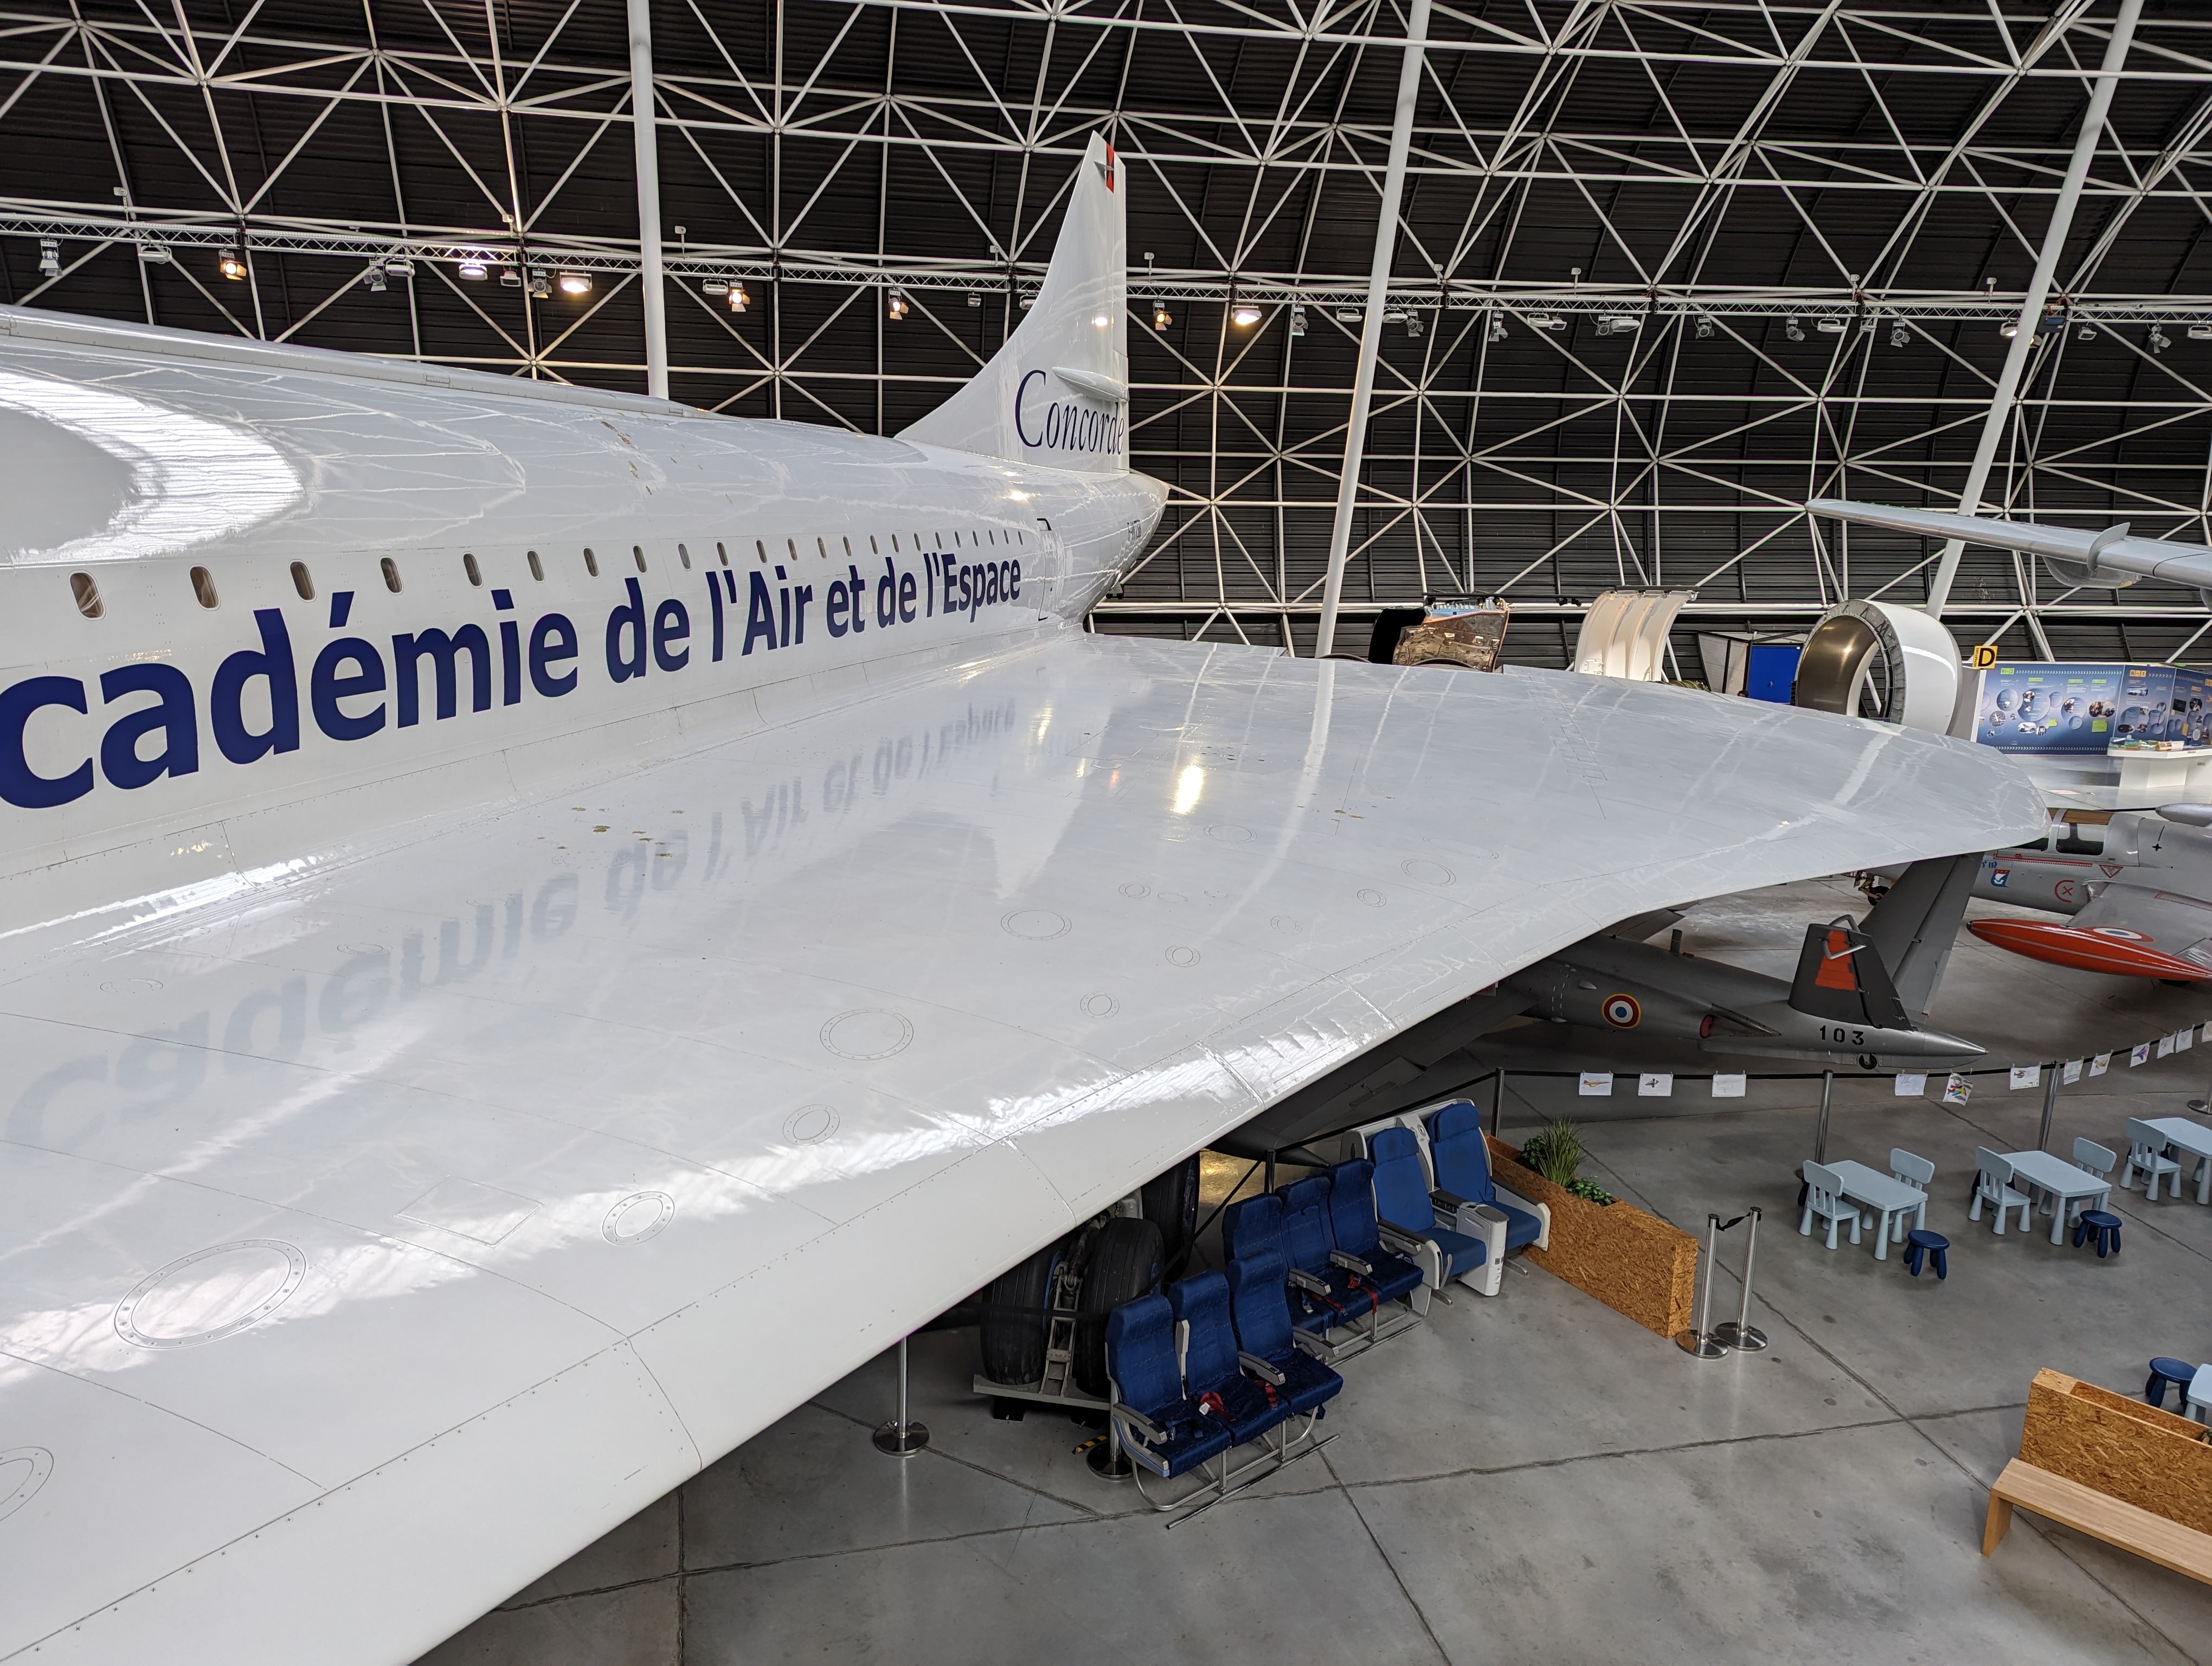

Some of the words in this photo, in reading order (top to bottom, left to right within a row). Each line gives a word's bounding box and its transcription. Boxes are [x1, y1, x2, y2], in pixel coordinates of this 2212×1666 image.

[1015, 369, 1125, 456] Concorde
[1127, 519, 1142, 541] F-WTSB
[1978, 648, 1995, 667] D
[0, 590, 579, 809] cadémie
[606, 576, 690, 683] de
[705, 565, 813, 662] l'Air
[826, 564, 866, 639] et
[877, 556, 917, 628] de
[923, 552, 1021, 623] l'Espace
[1819, 1025, 1864, 1046] 103
